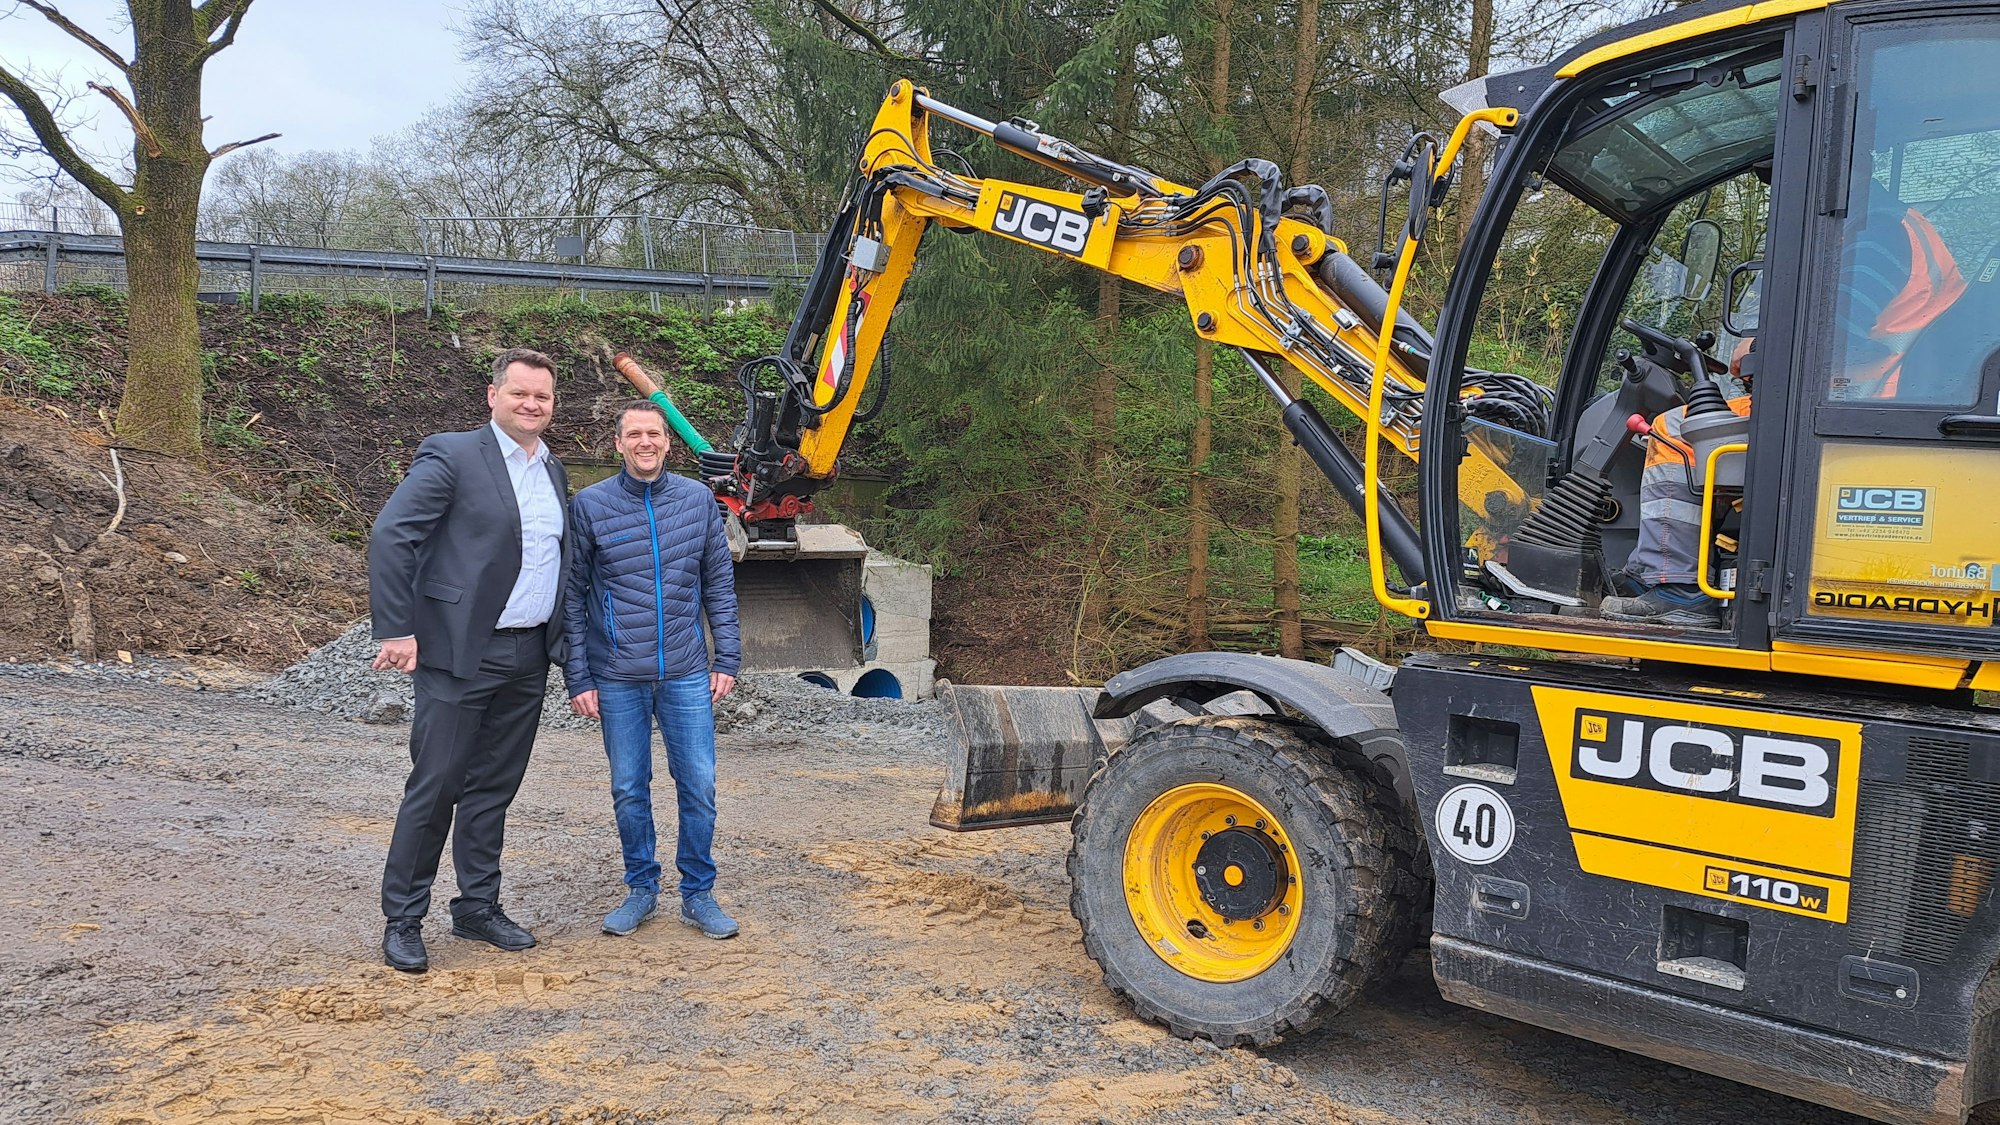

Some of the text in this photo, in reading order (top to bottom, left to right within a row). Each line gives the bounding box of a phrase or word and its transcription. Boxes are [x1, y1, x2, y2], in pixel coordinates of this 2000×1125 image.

[995, 198, 1089, 252] JCB
[1838, 514, 1877, 522] VERTRIEB
[1887, 516, 1922, 524] SERVICE
[1840, 488, 1923, 510] JCB
[1578, 719, 1829, 808] JCB
[1453, 799, 1496, 849] 40
